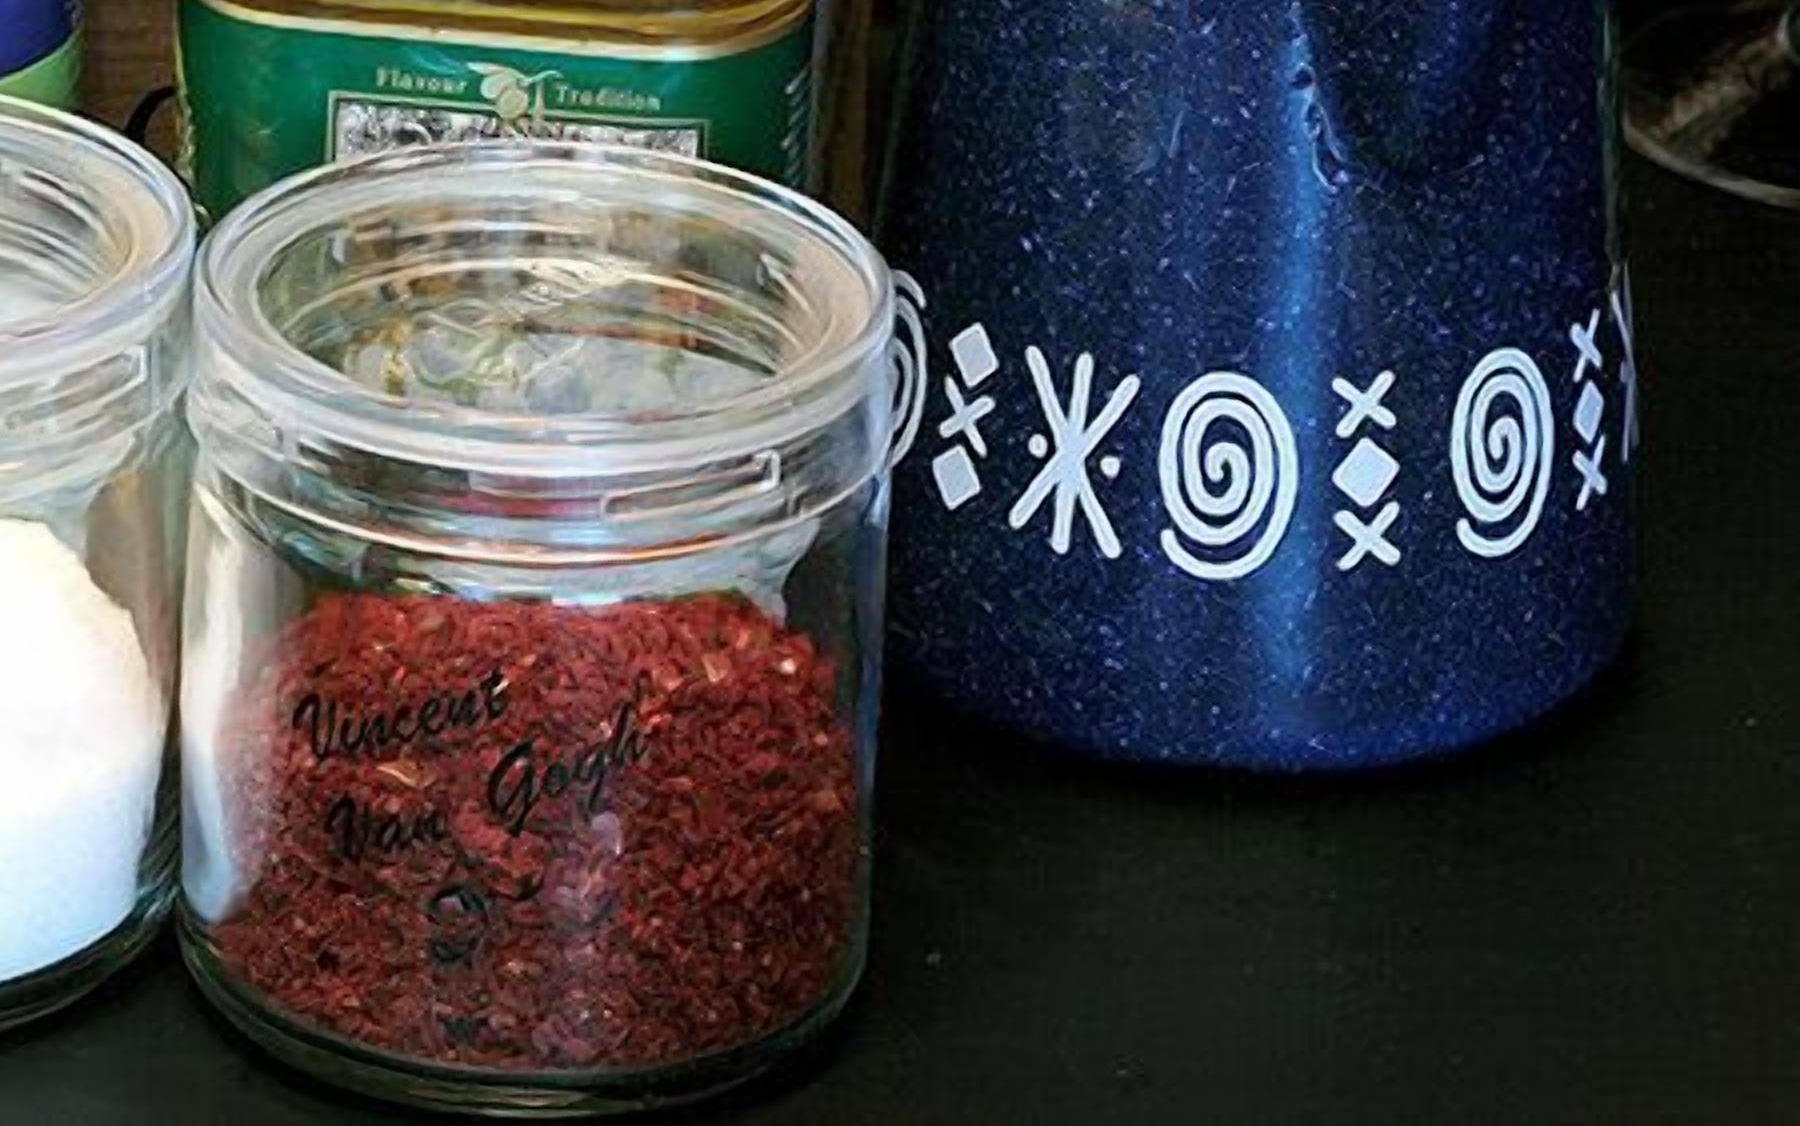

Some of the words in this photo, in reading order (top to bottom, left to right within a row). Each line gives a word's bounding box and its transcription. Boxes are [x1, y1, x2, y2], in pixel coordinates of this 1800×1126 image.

[375, 65, 468, 93] Flavour
[293, 669, 511, 761] Vincent
[486, 701, 651, 836] Gogh
